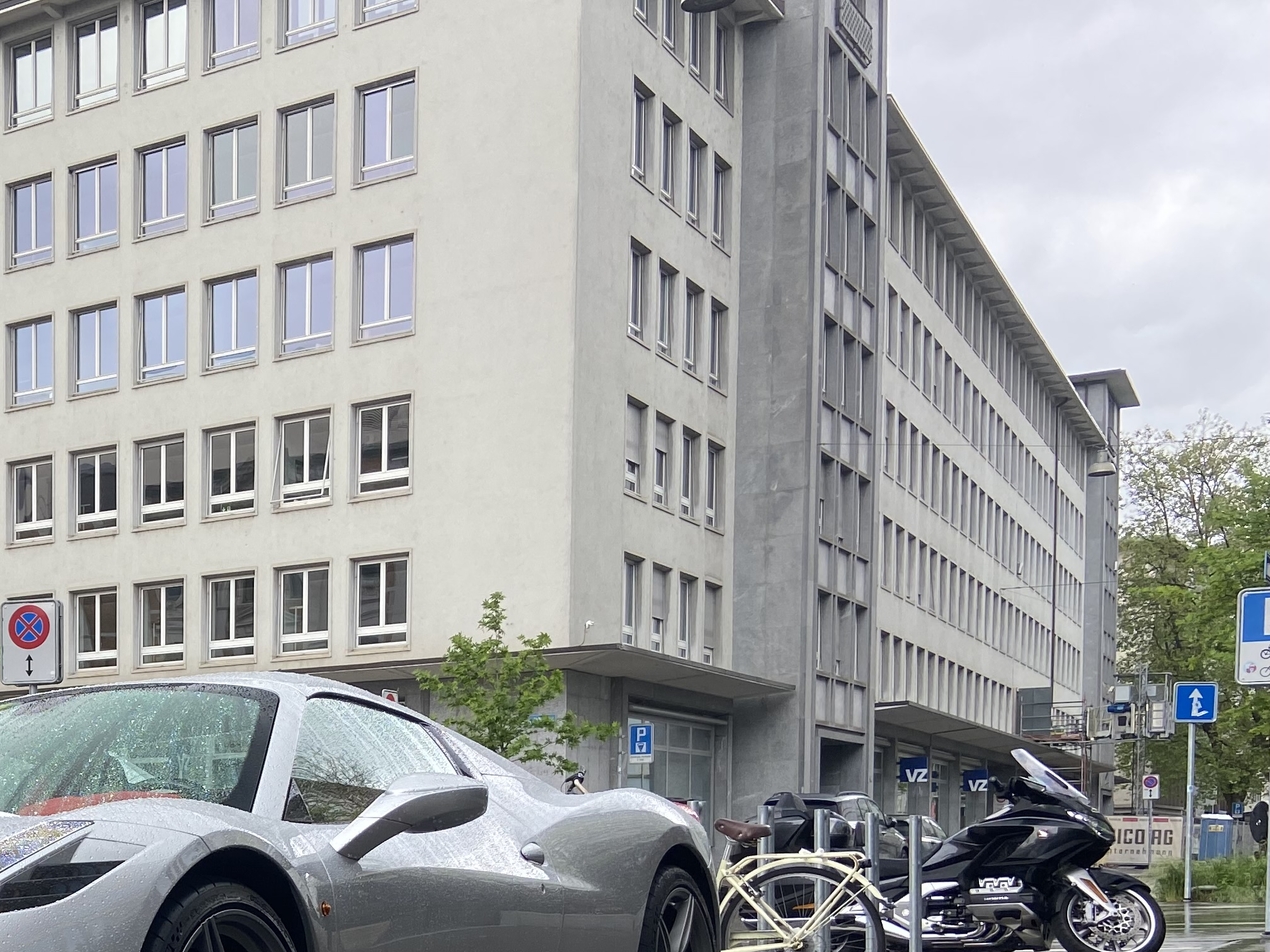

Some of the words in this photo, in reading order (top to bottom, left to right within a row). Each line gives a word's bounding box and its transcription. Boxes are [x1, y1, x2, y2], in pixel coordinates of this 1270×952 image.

[636, 727, 646, 741] P
[905, 768, 928, 783] VZ
[968, 779, 988, 792] VZ
[1116, 829, 1145, 845] ICO
[1150, 829, 1173, 845] AG
